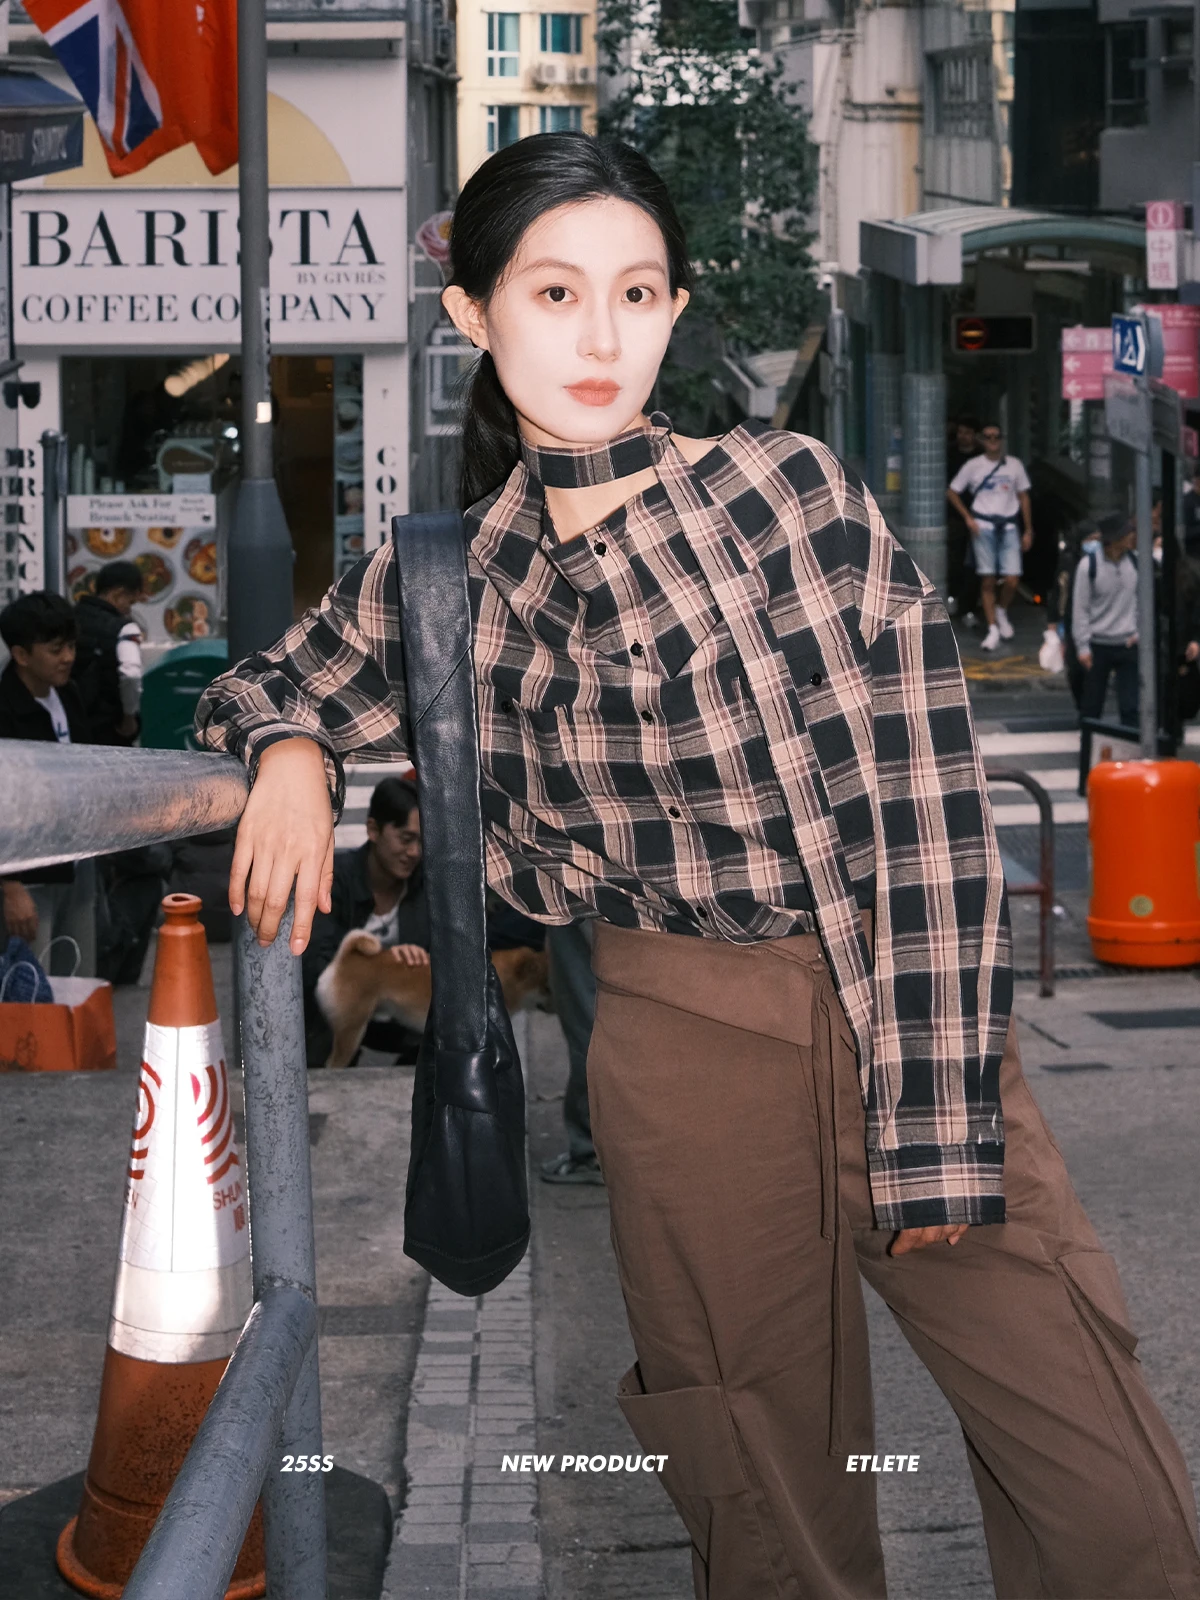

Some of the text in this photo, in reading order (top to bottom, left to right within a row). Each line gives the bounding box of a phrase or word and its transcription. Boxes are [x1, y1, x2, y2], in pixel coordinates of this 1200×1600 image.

[20, 209, 386, 267] BARITA
[297, 272, 318, 286] BY
[21, 294, 387, 323] COFFEE COPANY
[128, 498, 149, 509] Ask
[17, 448, 38, 597] BRUNC
